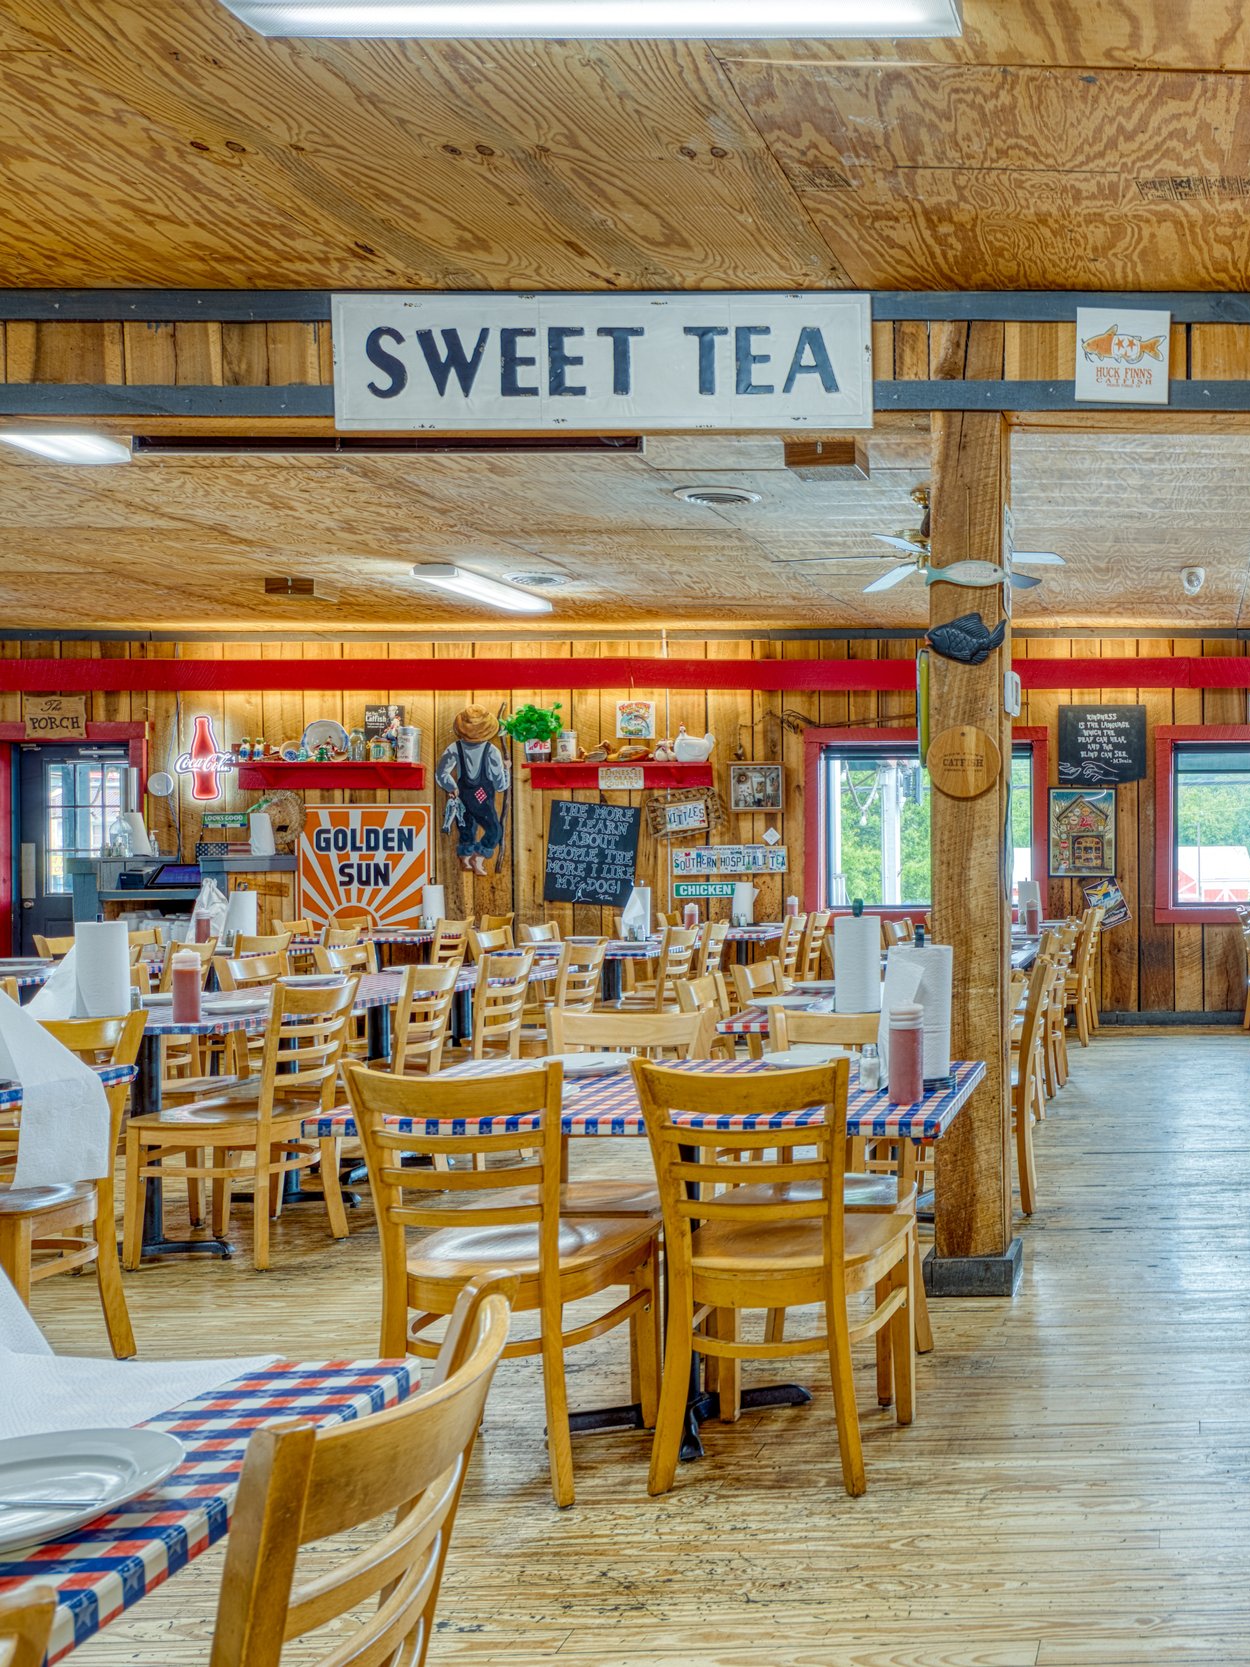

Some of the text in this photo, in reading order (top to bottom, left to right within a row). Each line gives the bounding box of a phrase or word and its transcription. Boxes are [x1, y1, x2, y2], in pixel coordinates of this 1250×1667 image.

[366, 325, 840, 398] SWEET TEA
[1096, 366, 1153, 379] HUCK FINN'S
[41, 700, 62, 712] The
[29, 716, 81, 729] PORCH
[1086, 713, 1117, 721] KINDNESS
[1101, 721, 1130, 729] LANGUAGE
[1080, 750, 1098, 759] BLIND
[1102, 743, 1113, 751] THE
[560, 802, 634, 823] THE MORE
[668, 806, 705, 825] VITTLES
[563, 816, 629, 835] I LEARN
[315, 827, 414, 852] GOLDEN
[567, 832, 619, 849] ABOUT
[548, 844, 634, 865] PEOPLE THE
[674, 853, 786, 871] SOUTHERN HOSPITALI TEA
[338, 862, 390, 887] SUN
[546, 859, 635, 880] MORE I LIKE
[555, 875, 620, 894] MY DOG!
[679, 884, 732, 895] CHICKEN
